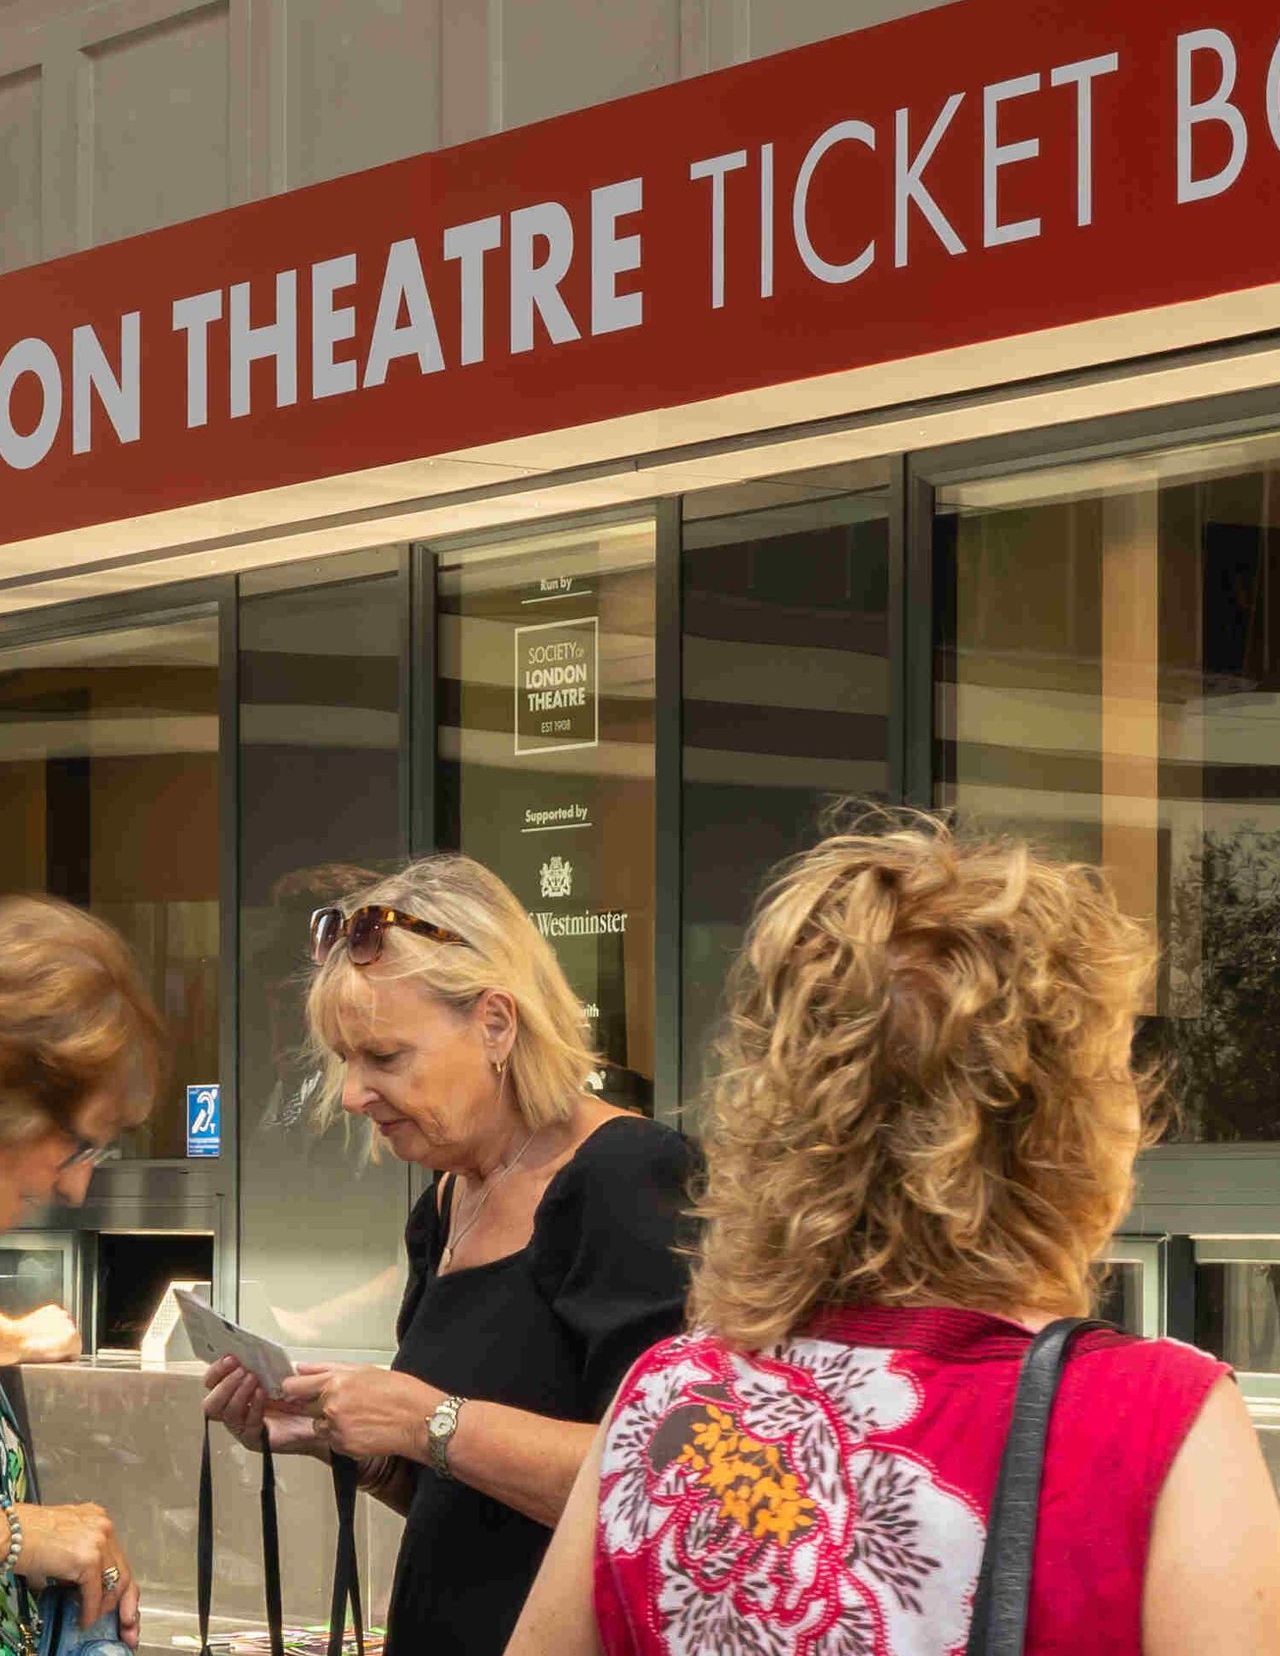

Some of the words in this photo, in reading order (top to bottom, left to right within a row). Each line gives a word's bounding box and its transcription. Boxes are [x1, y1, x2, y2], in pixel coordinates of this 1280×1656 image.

[172, 176, 644, 429] THEATRE
[690, 56, 1119, 310] TICKET
[540, 579, 559, 591] Run
[560, 576, 572, 590] by
[528, 642, 576, 665] SOCIETY
[525, 664, 587, 689] LONDON
[527, 688, 586, 712] THEATRE
[541, 722, 552, 733] EST
[553, 719, 571, 731] 1908
[525, 804, 574, 825] Supported
[575, 804, 588, 821] by
[536, 910, 628, 937] Westminster
